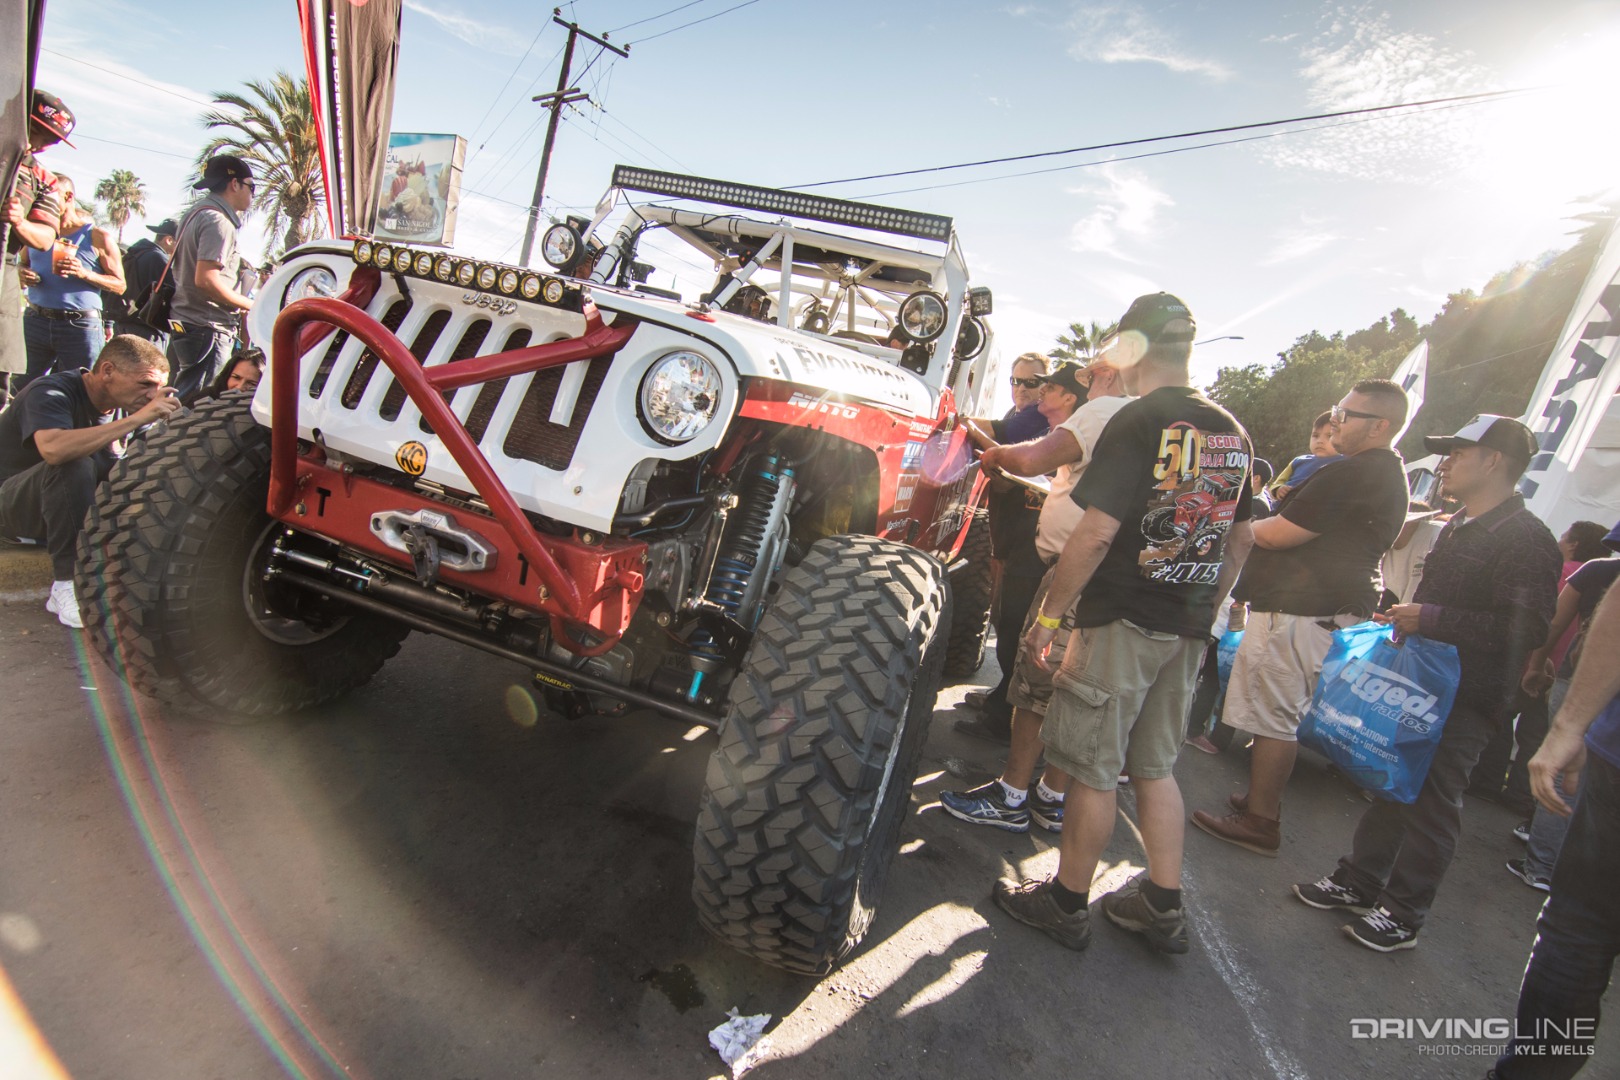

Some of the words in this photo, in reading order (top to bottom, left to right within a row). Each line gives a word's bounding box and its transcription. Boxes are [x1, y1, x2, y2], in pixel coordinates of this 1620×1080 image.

[329, 12, 338, 50] THE
[462, 291, 518, 316] Jeep
[787, 391, 860, 419] NITTO
[401, 445, 423, 472] KC
[1199, 453, 1225, 468] BAJA
[1195, 534, 1217, 548] NITTO
[536, 673, 572, 690] DYNATRAC
[1371, 702, 1431, 734] radios
